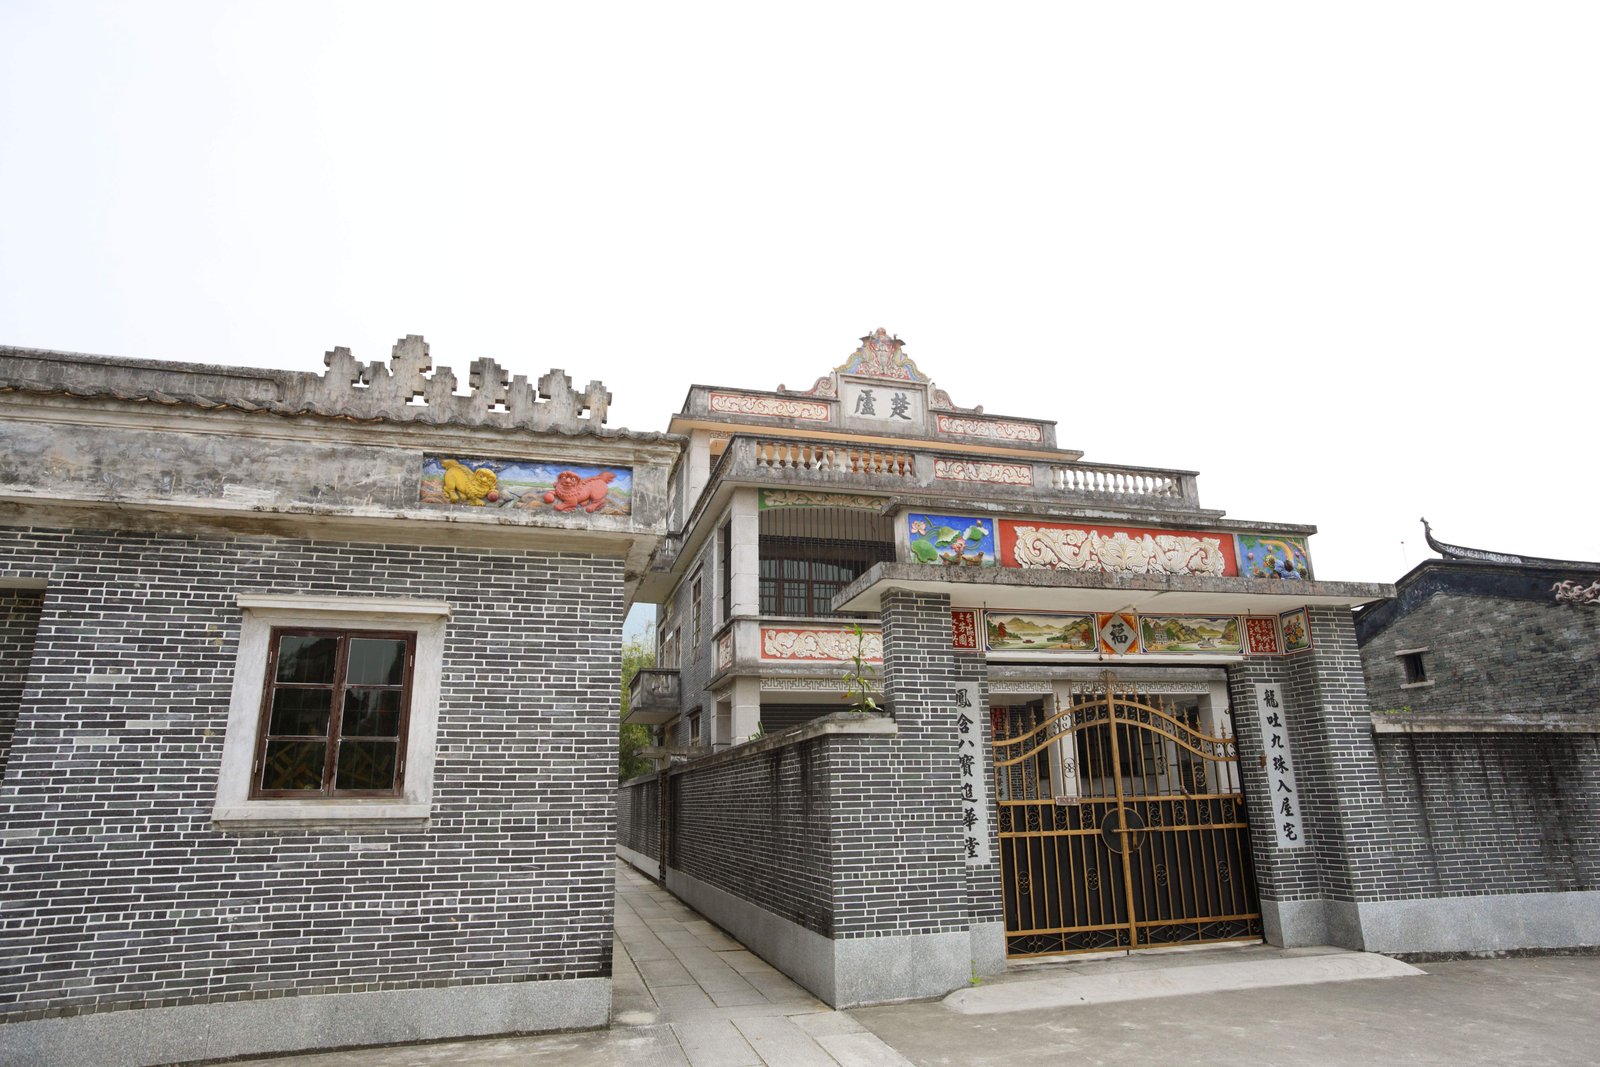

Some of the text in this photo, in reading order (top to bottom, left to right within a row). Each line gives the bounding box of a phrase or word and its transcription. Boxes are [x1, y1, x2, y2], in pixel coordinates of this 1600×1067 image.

[1109, 622, 1129, 646] 福
[1263, 688, 1298, 841] 龍吐九珠入屋宅
